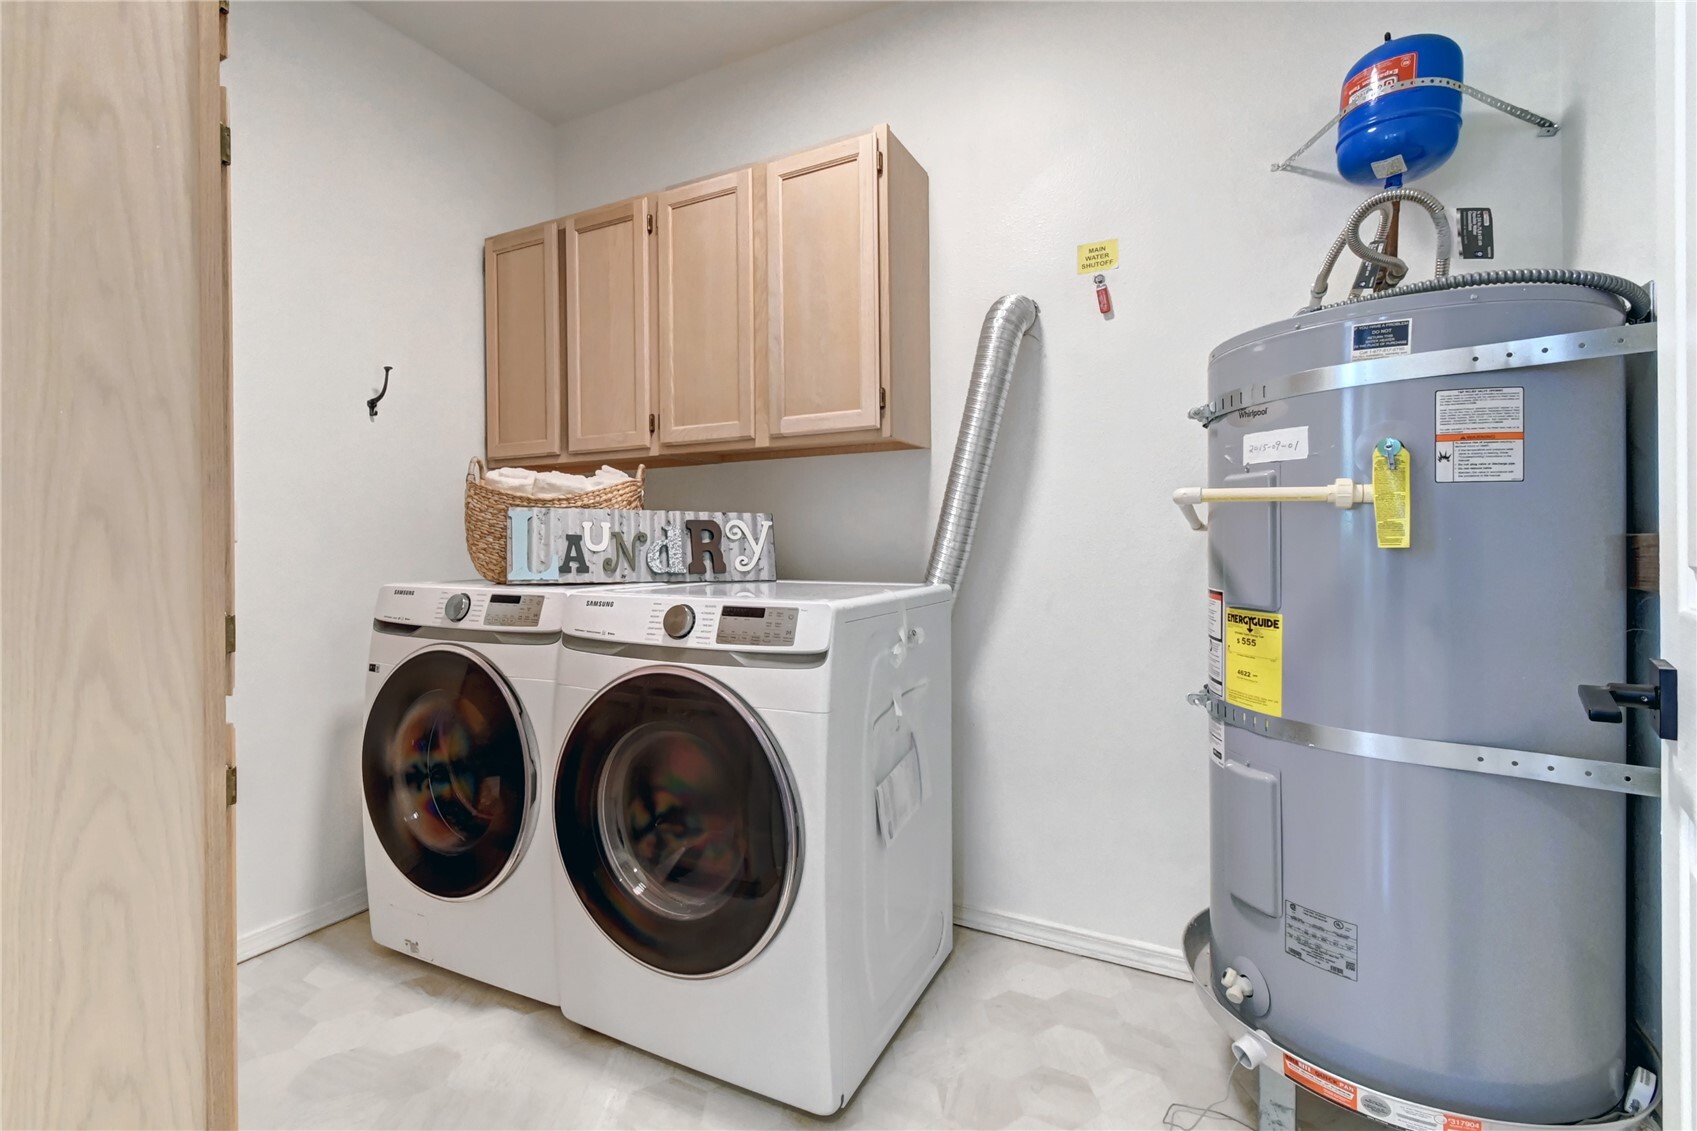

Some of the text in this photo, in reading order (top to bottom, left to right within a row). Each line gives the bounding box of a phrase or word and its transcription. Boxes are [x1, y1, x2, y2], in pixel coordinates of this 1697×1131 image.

[1089, 246, 1106, 254] MAIN
[1085, 252, 1110, 262] WATER
[1081, 259, 1114, 270] SHUTOFF
[1238, 407, 1269, 419] Whirlpool
[1249, 440, 1299, 453] 2015-09-01
[585, 600, 614, 608] SAMSUNG
[1227, 613, 1280, 629] ENERGYGUIDE
[1241, 637, 1257, 647] 555
